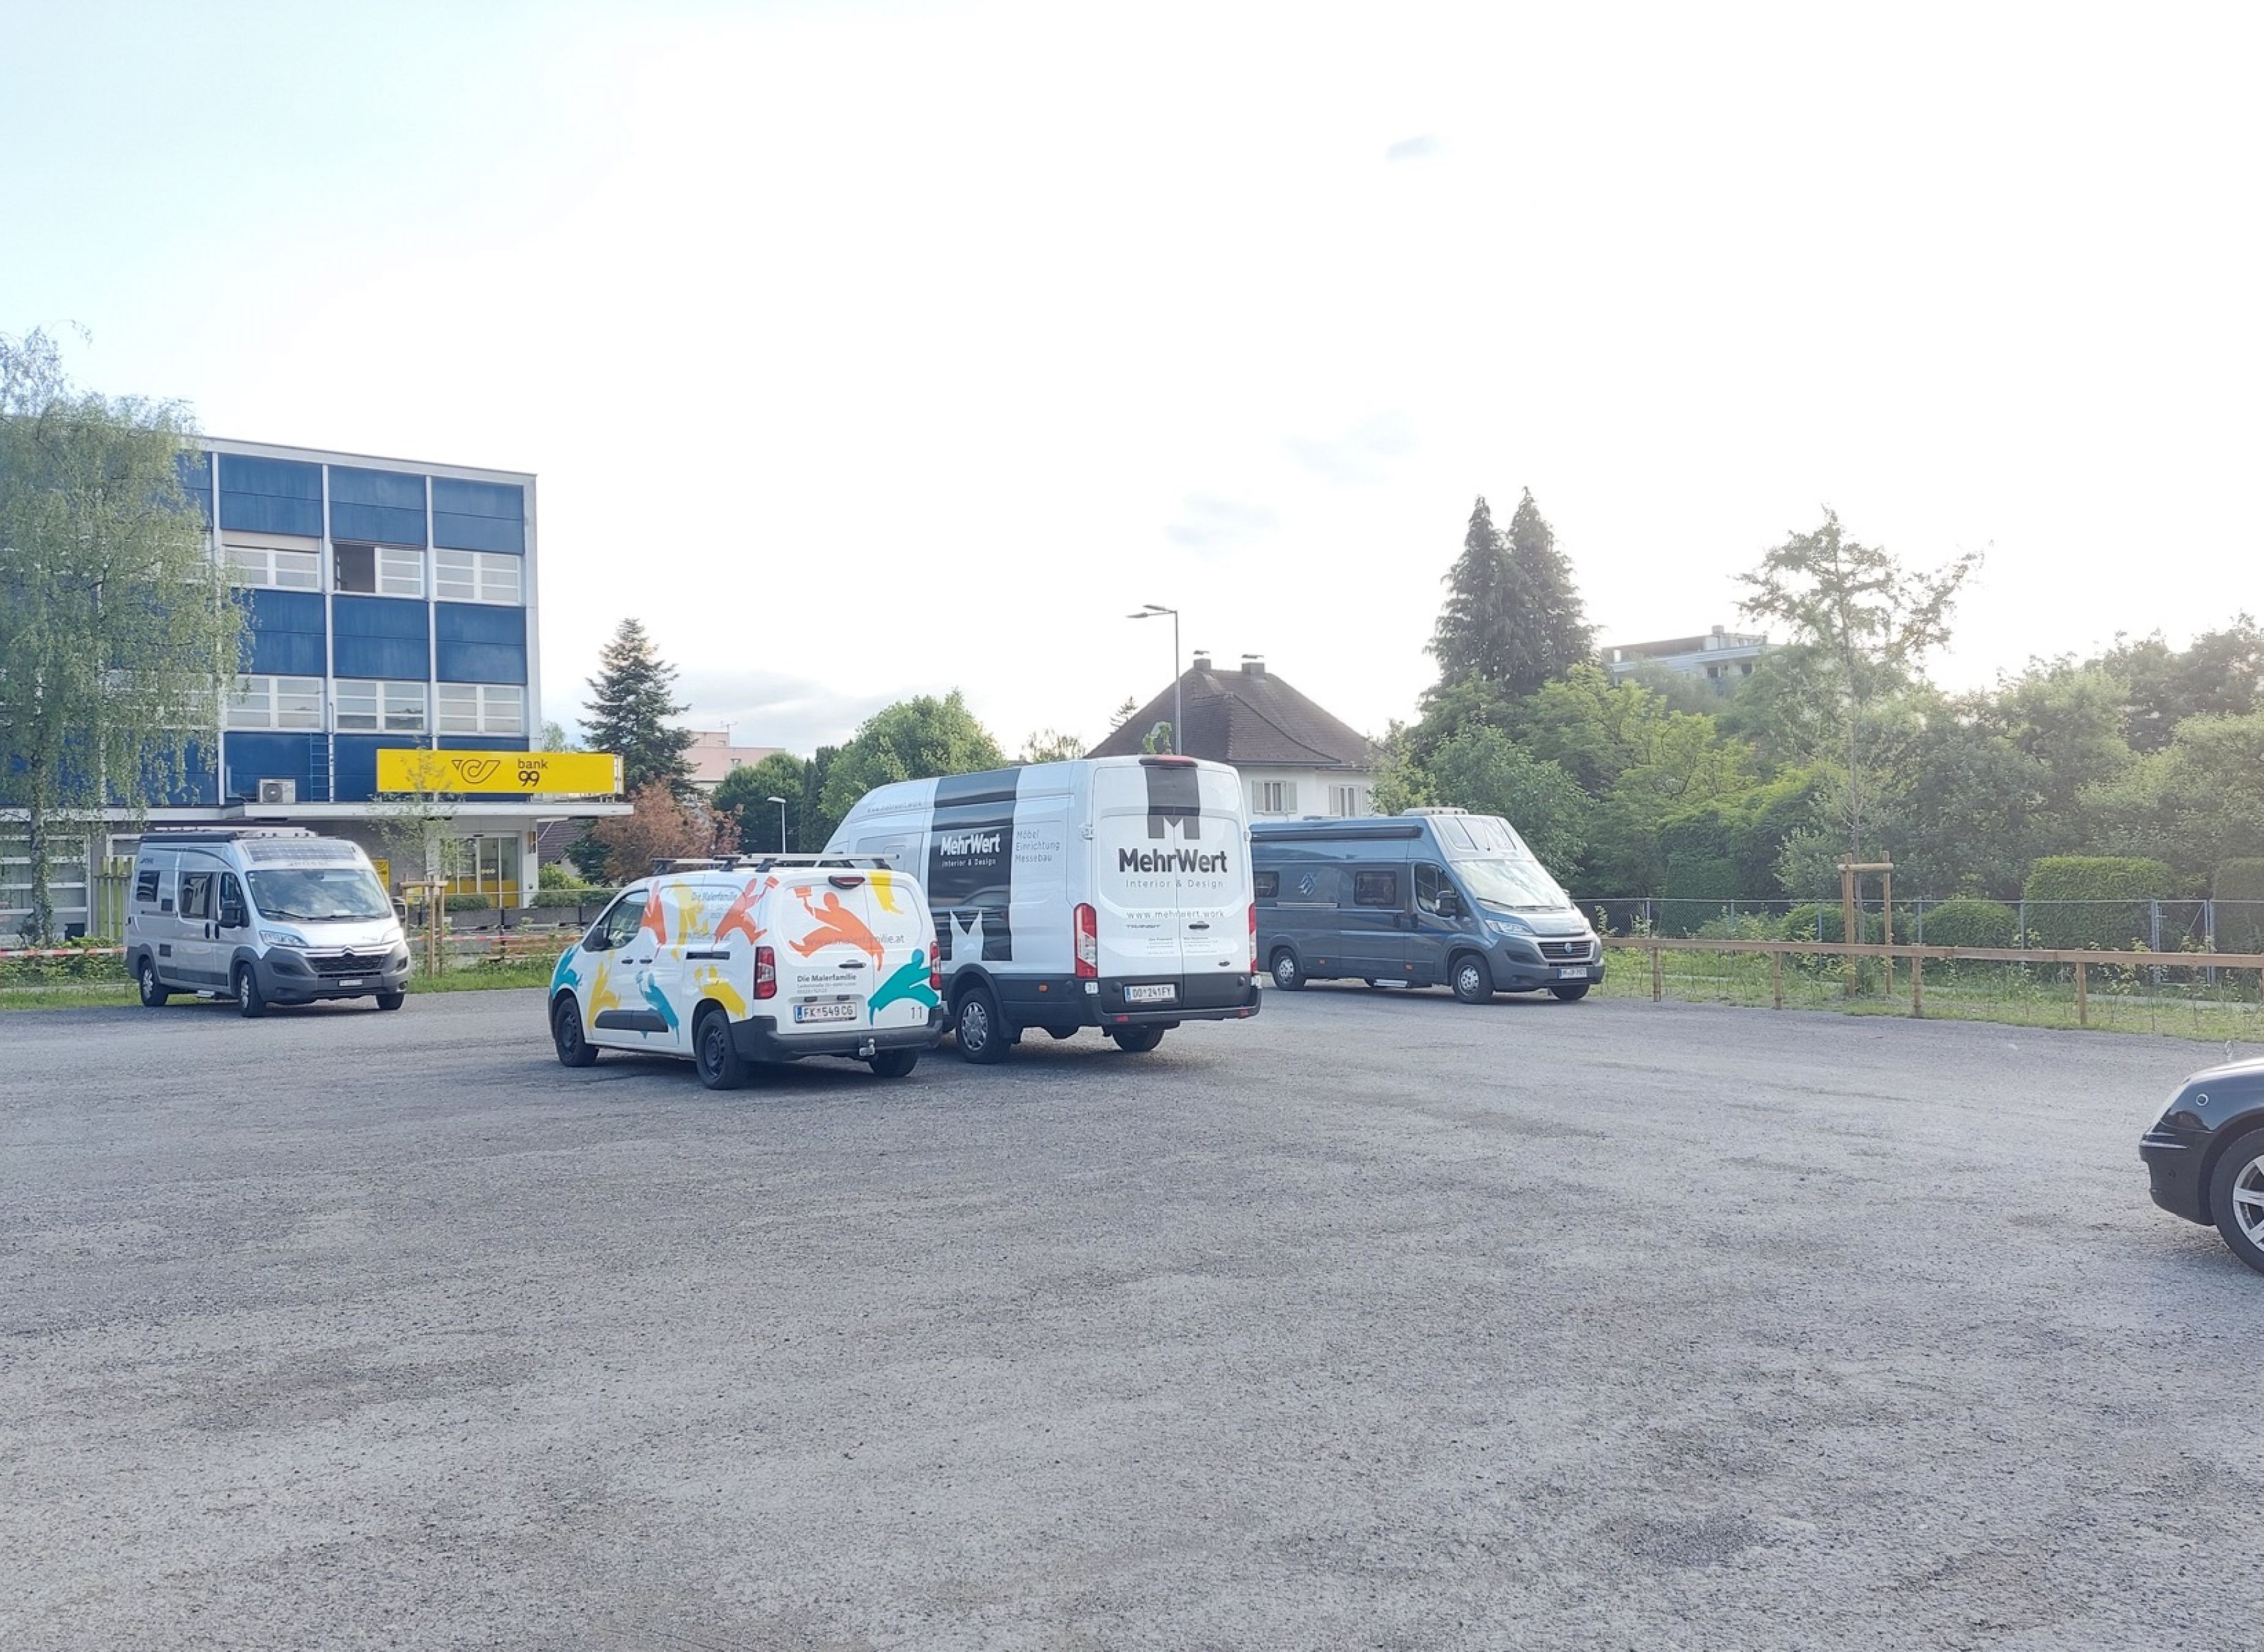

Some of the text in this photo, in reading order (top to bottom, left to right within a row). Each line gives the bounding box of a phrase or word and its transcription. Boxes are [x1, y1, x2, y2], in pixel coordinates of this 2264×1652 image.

[518, 758, 549, 769] bank
[518, 770, 540, 787] 99
[1017, 830, 1039, 839] Möbel
[940, 832, 1000, 855] MehrWert
[1016, 841, 1061, 852] Einrichtung
[941, 859, 966, 868] Interior
[974, 858, 997, 866] Design
[1015, 854, 1052, 863] Messebau
[1118, 847, 1227, 873] MehrWert
[1126, 879, 1171, 888] Interior
[1188, 879, 1224, 890] Design
[1126, 909, 1224, 919] www.mehrwert.work
[811, 973, 857, 982] Malerfamilie
[910, 1006, 923, 1019] 11
